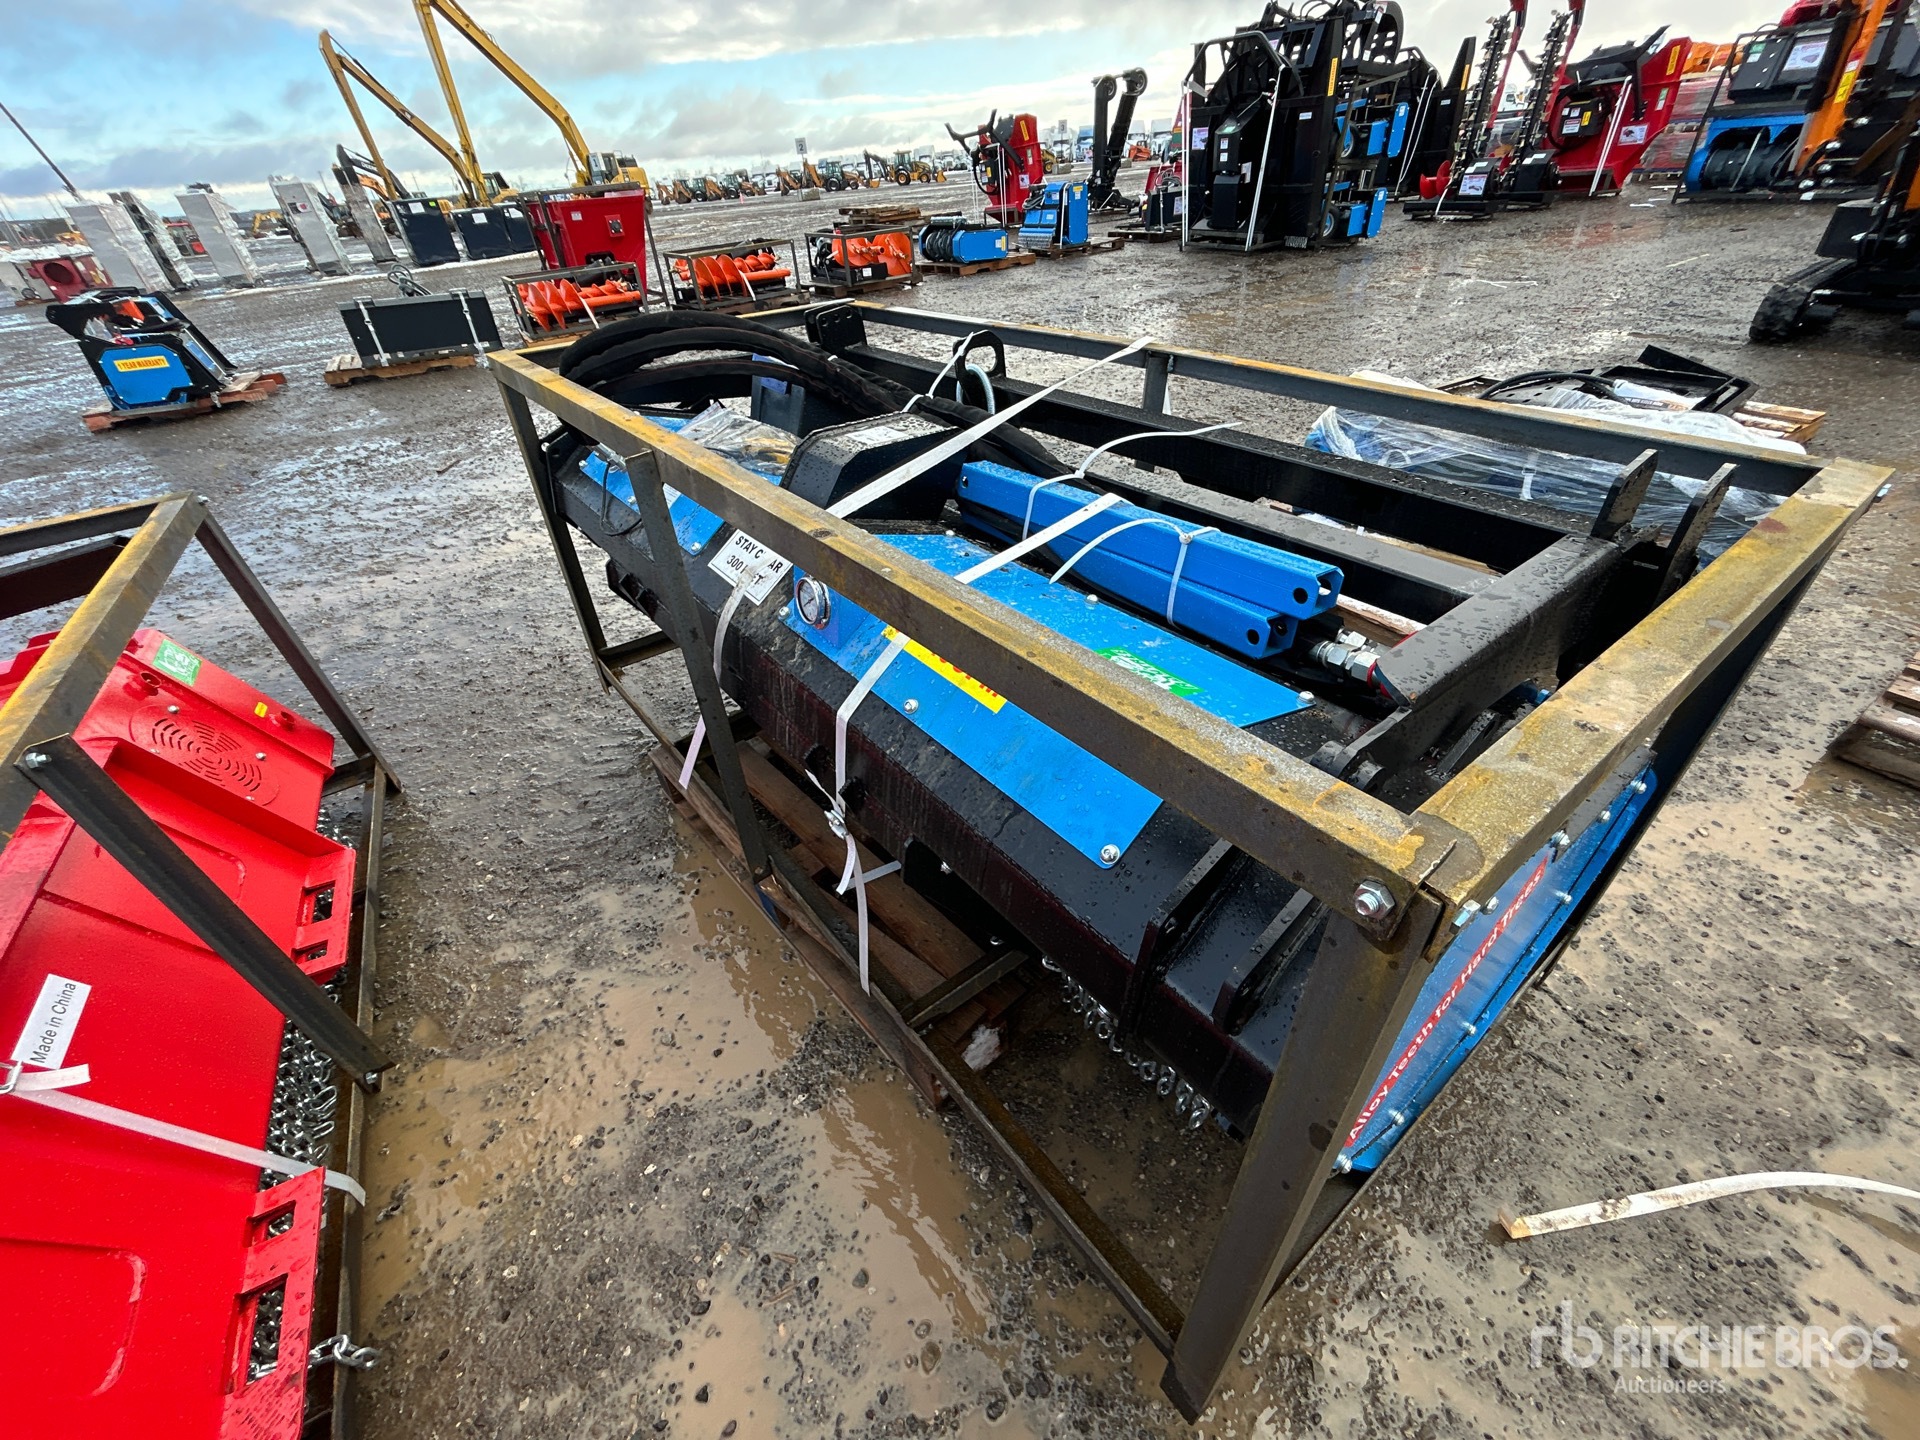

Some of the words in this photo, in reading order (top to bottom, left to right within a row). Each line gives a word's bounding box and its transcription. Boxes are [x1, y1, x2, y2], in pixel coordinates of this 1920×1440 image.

[122, 361, 137, 370] YEAR
[136, 358, 166, 369] WARRANTY
[726, 555, 744, 571] 300
[735, 535, 758, 554] STAY
[754, 549, 783, 573] CAR
[52, 982, 77, 1015] China
[1350, 1085, 1388, 1139] Alloy
[1388, 1022, 1433, 1080] Teeth
[1435, 986, 1458, 1018] for
[1460, 927, 1499, 984] Hard
[1501, 869, 1542, 928] Trees
[45, 1016, 63, 1027] in
[30, 1029, 57, 1063] Made
